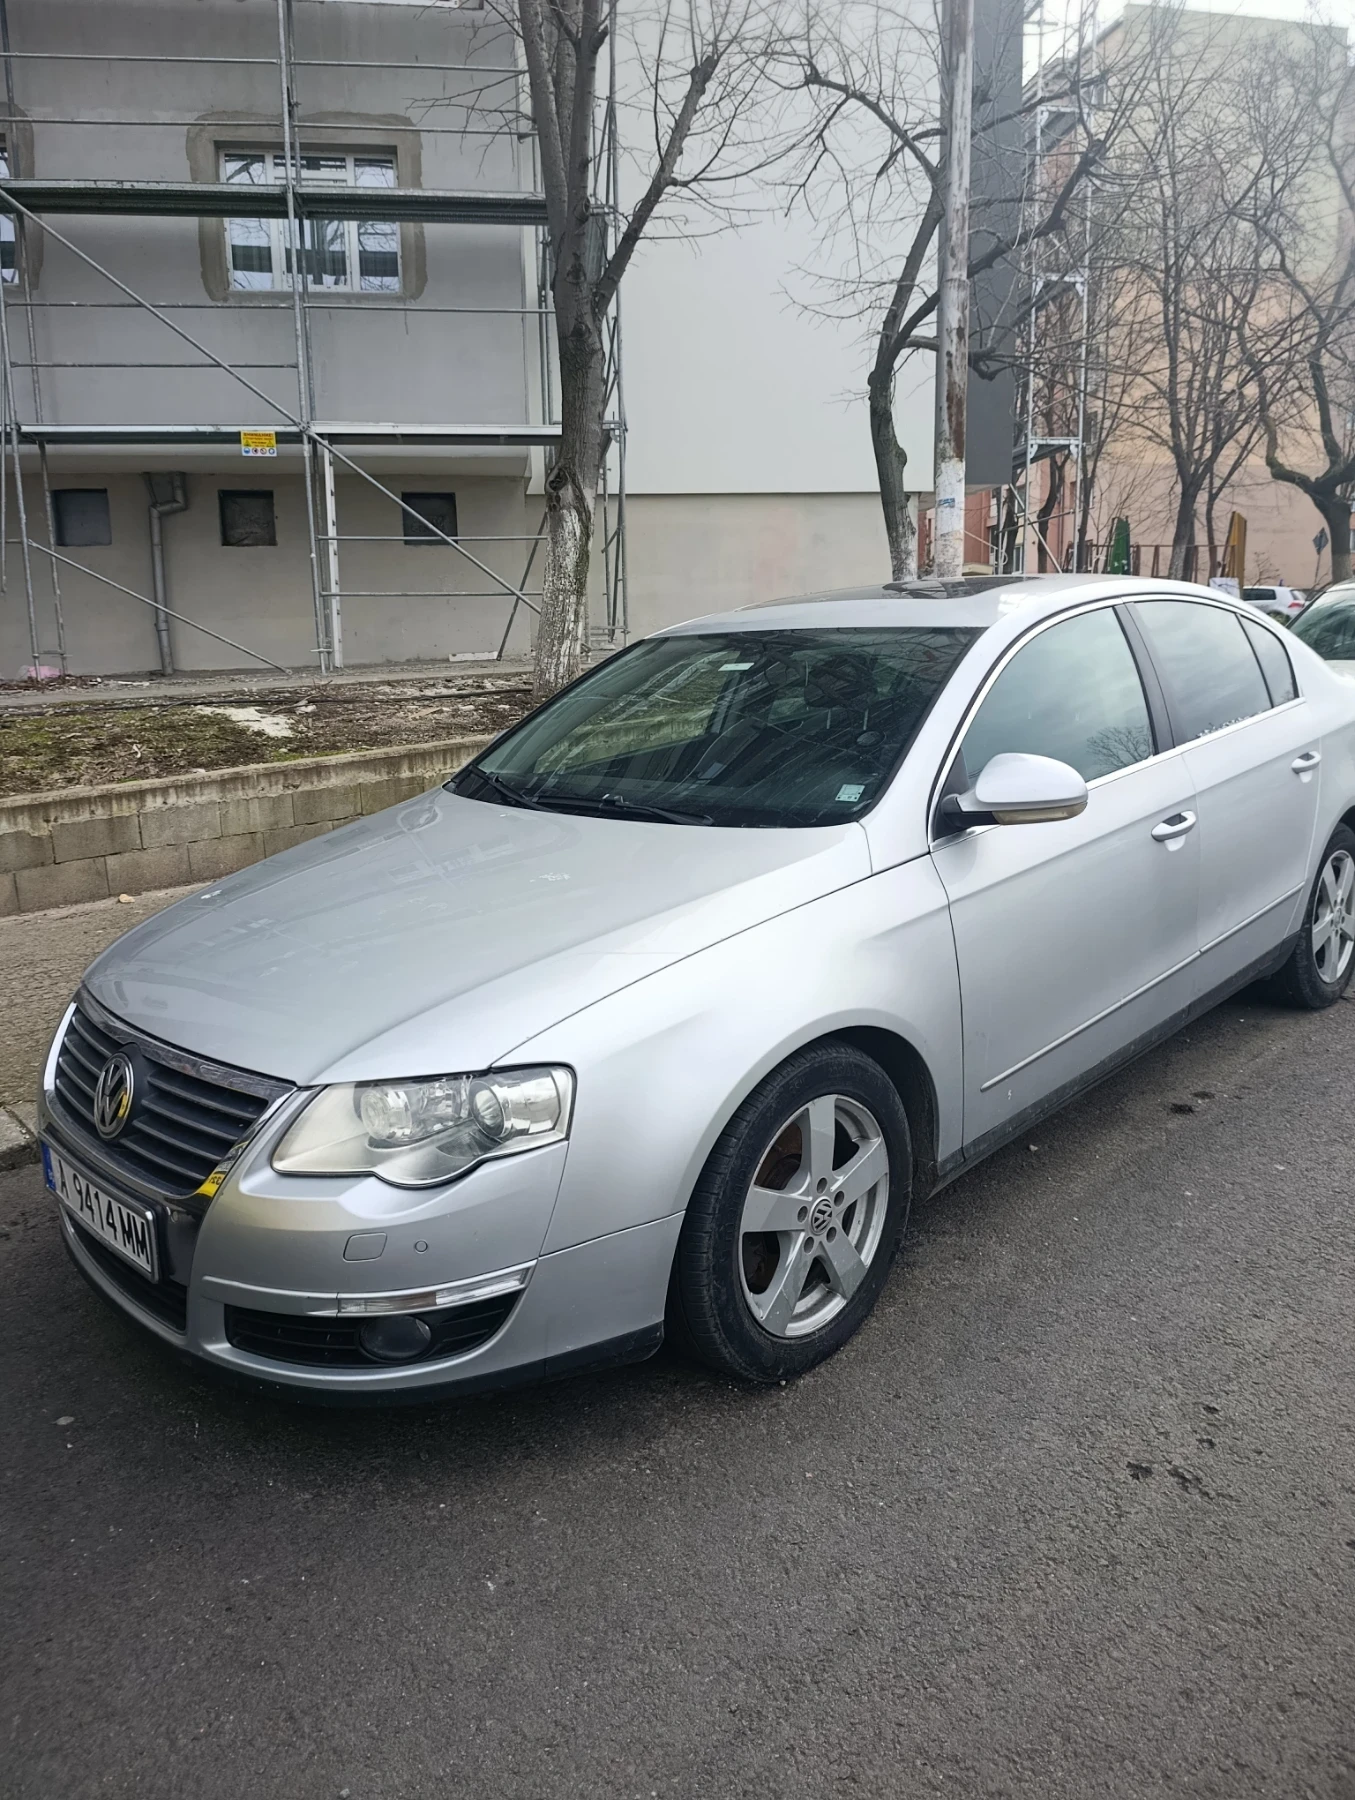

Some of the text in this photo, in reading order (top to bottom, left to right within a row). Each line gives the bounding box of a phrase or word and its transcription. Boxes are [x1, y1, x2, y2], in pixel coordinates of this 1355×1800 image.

[58, 1158, 150, 1265] A 9414 MM
